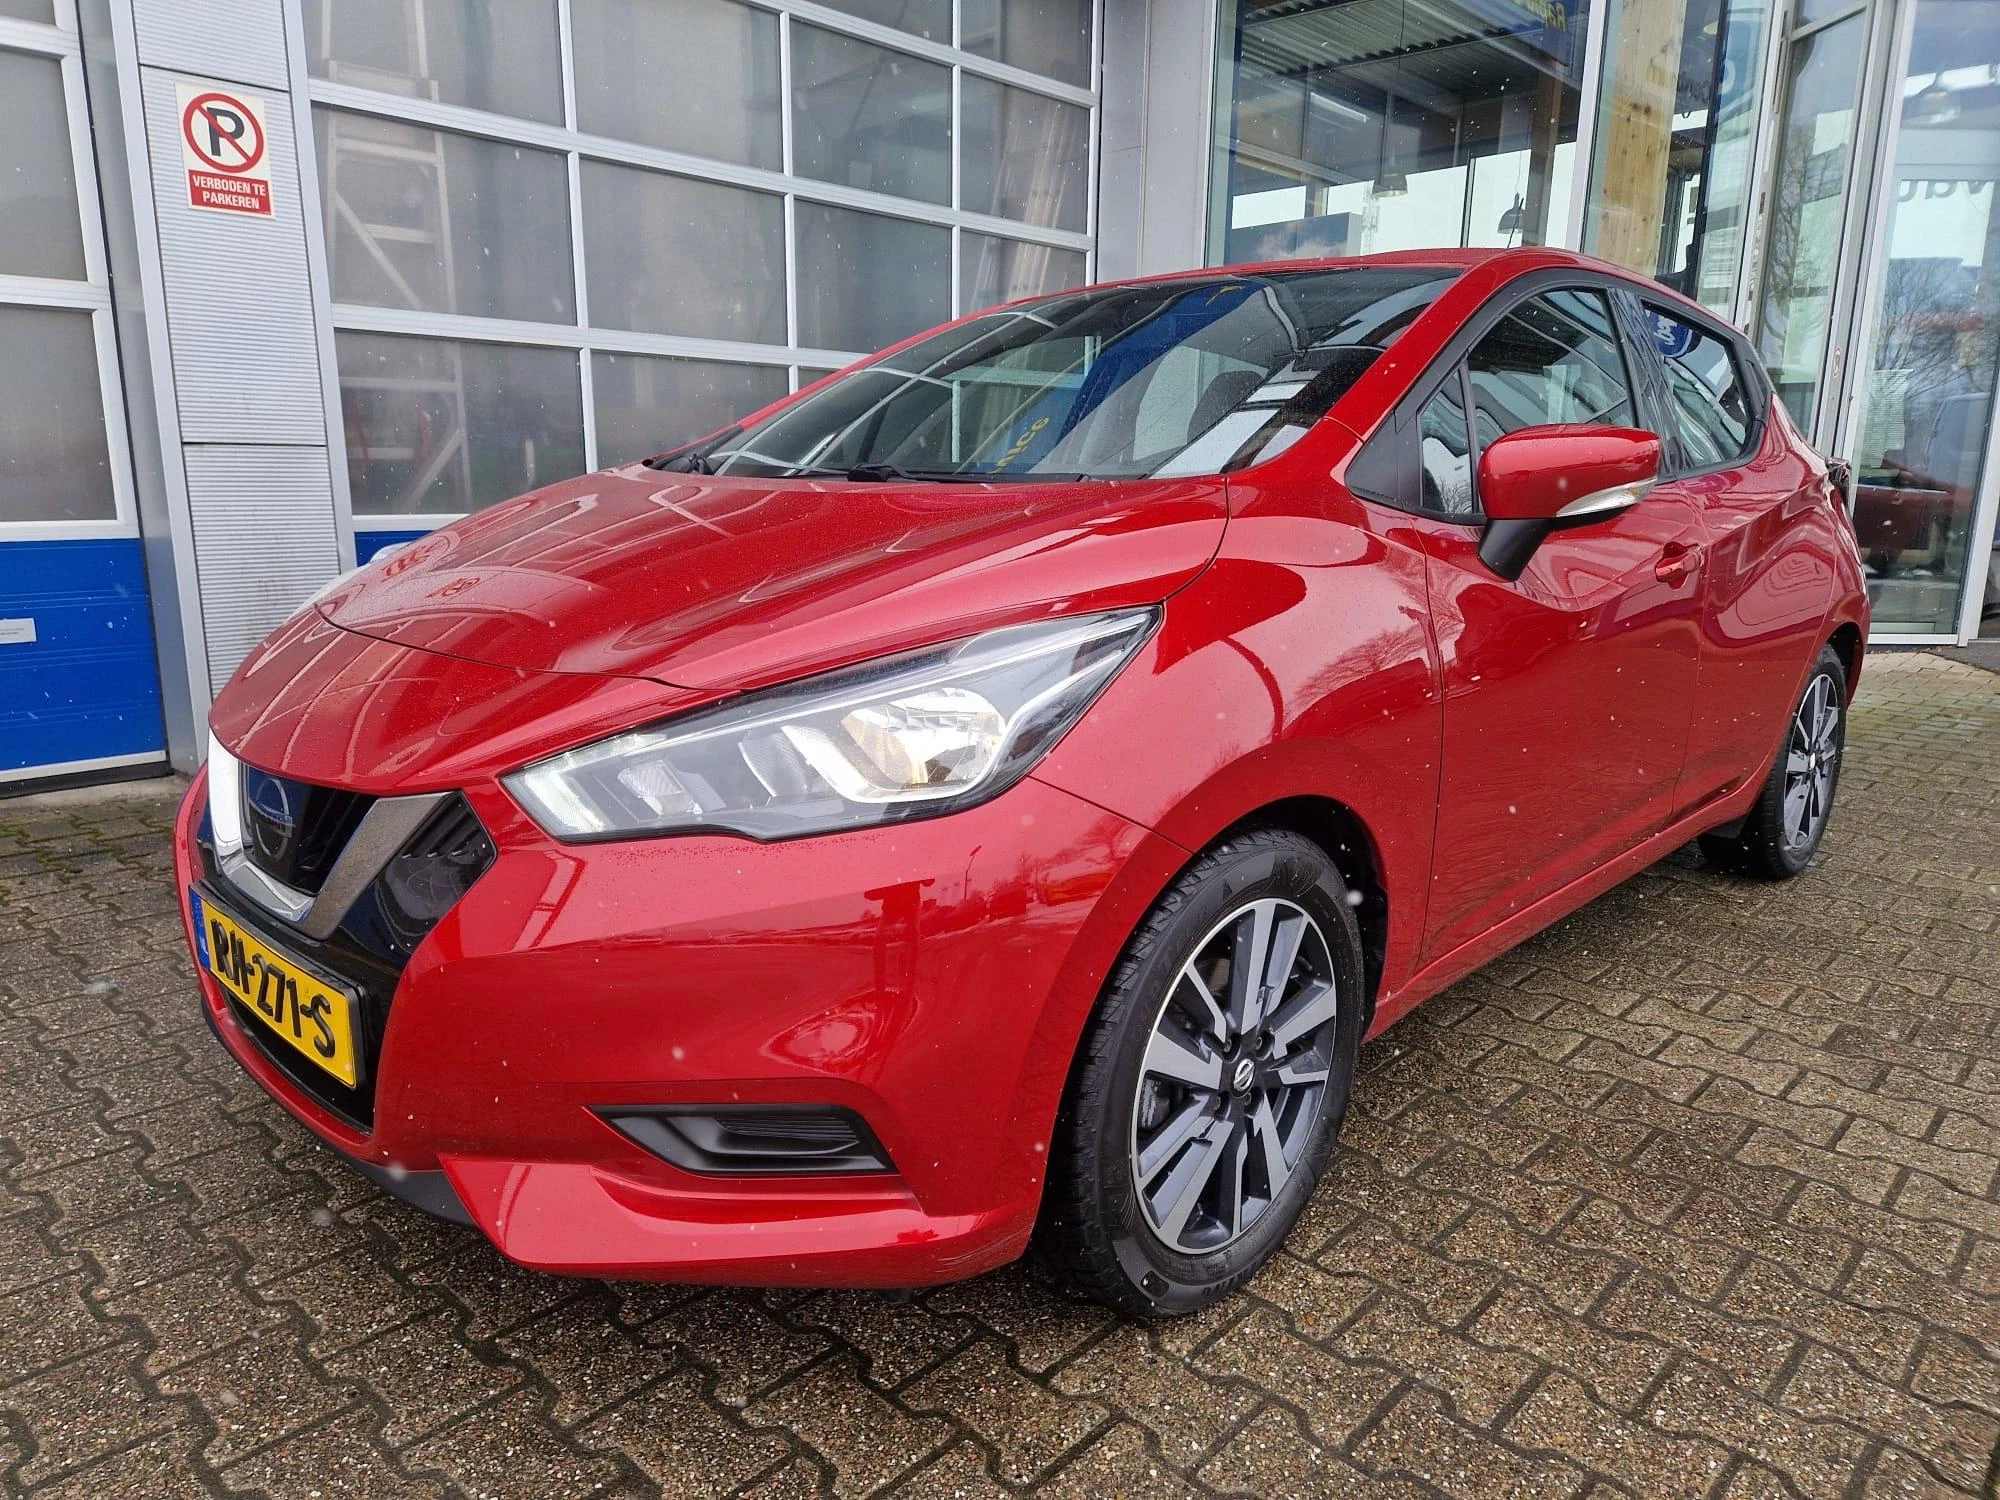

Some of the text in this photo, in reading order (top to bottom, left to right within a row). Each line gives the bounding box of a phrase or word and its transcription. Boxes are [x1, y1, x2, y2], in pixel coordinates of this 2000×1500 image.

[192, 174, 267, 197] VERBODEN TE
[202, 190, 260, 209] PARKEREN
[210, 918, 336, 1058] RH-271-S
